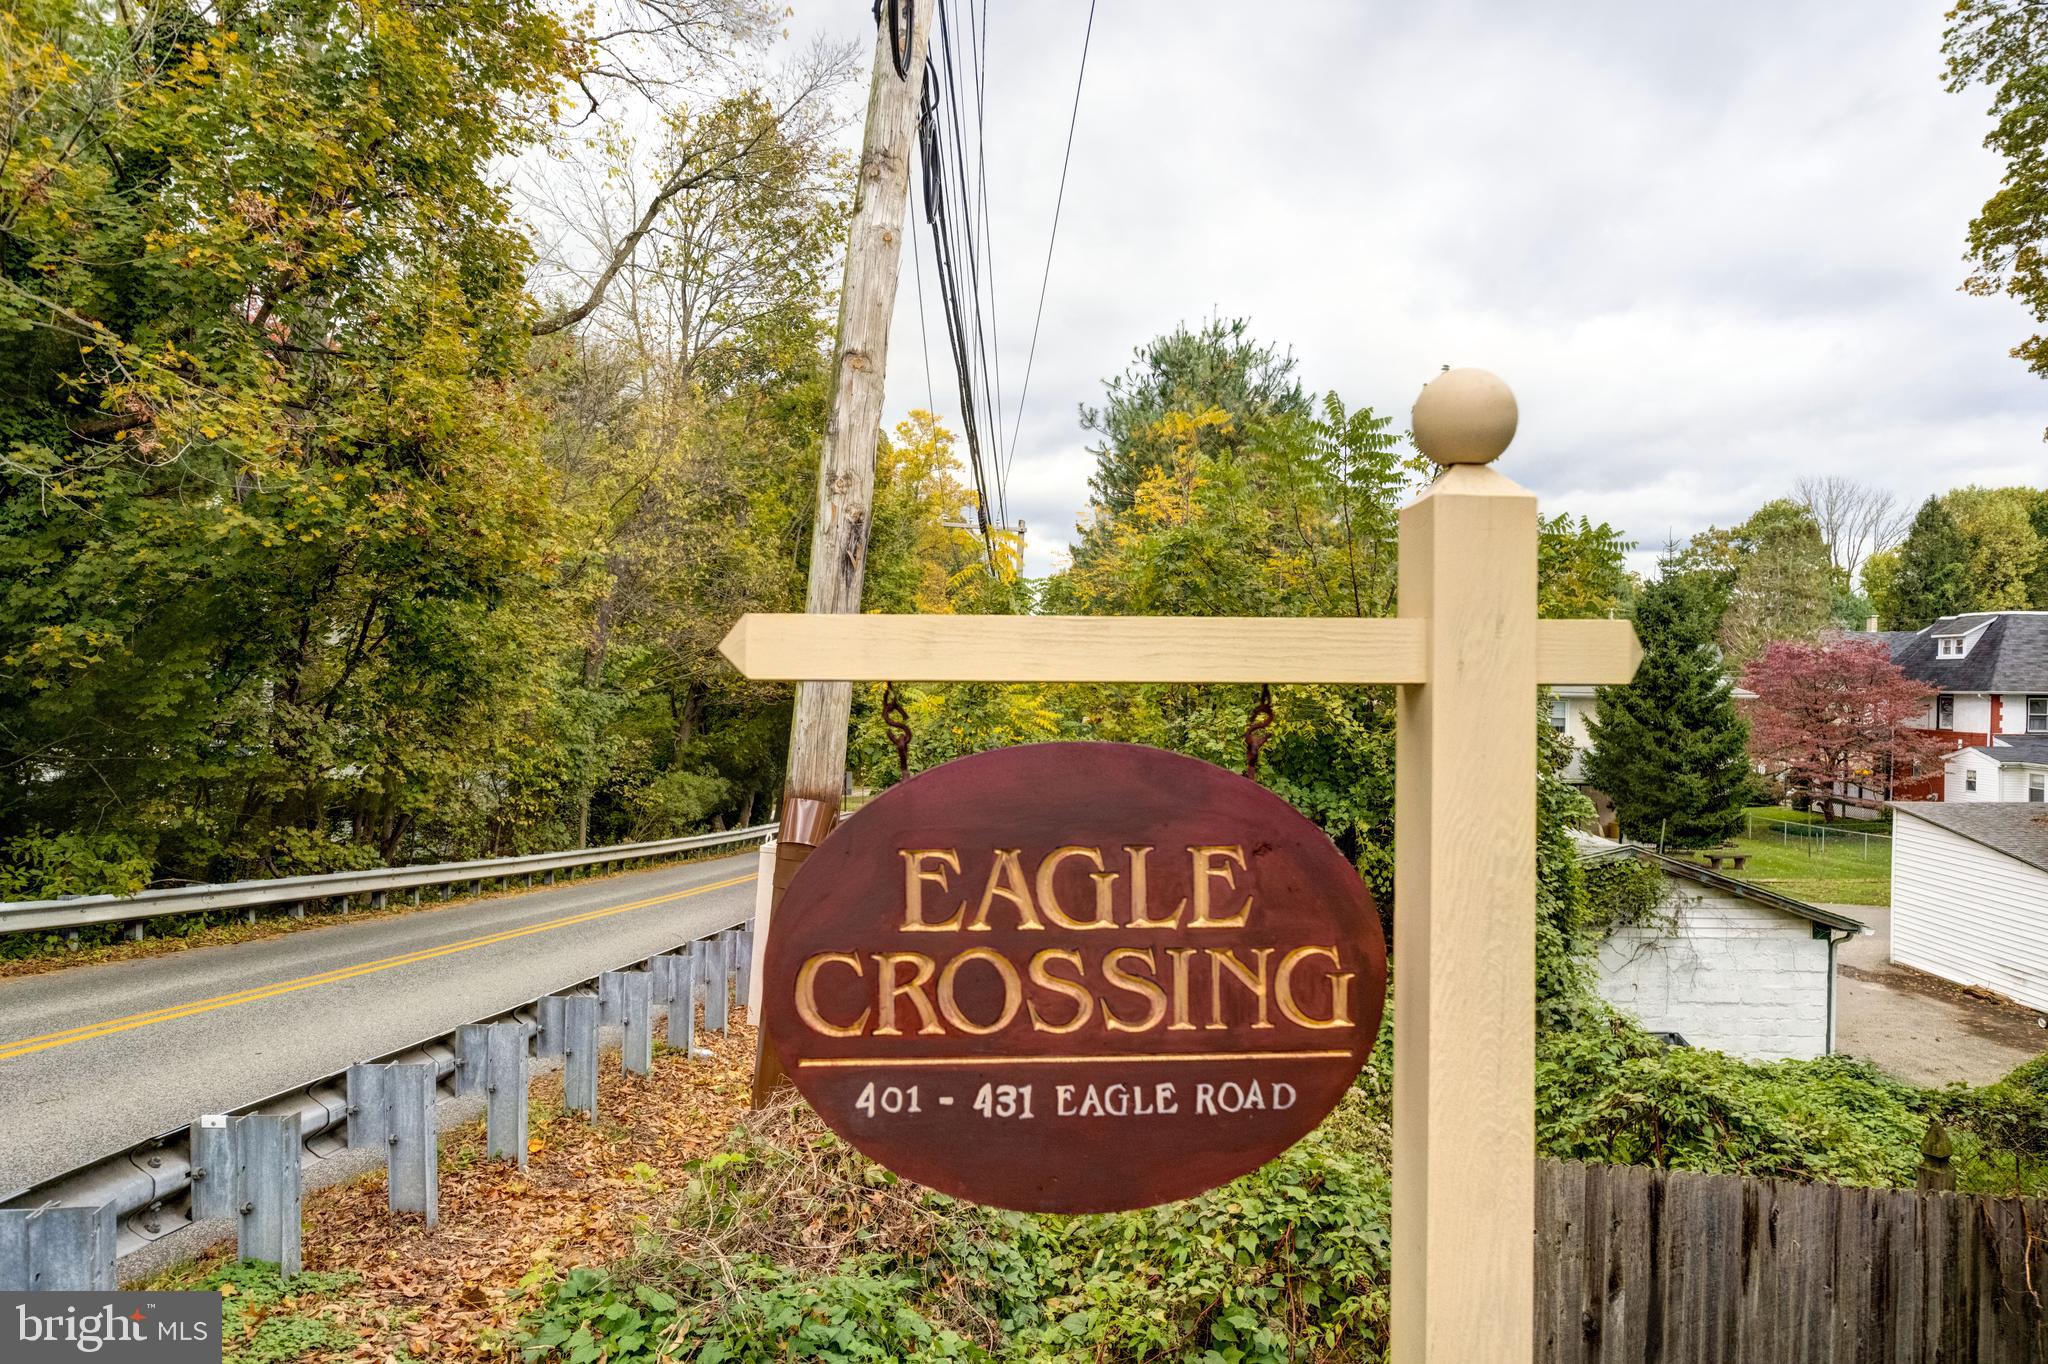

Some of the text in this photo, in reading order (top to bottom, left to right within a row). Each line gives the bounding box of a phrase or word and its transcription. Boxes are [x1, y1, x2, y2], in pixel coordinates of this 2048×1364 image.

[898, 845, 1254, 933] EAGLE
[795, 945, 1357, 1038] CROSSING
[854, 1081, 922, 1119] 401
[972, 1082, 1035, 1120] 431
[1055, 1082, 1179, 1117] EAGLE
[1195, 1078, 1297, 1116] ROAD
